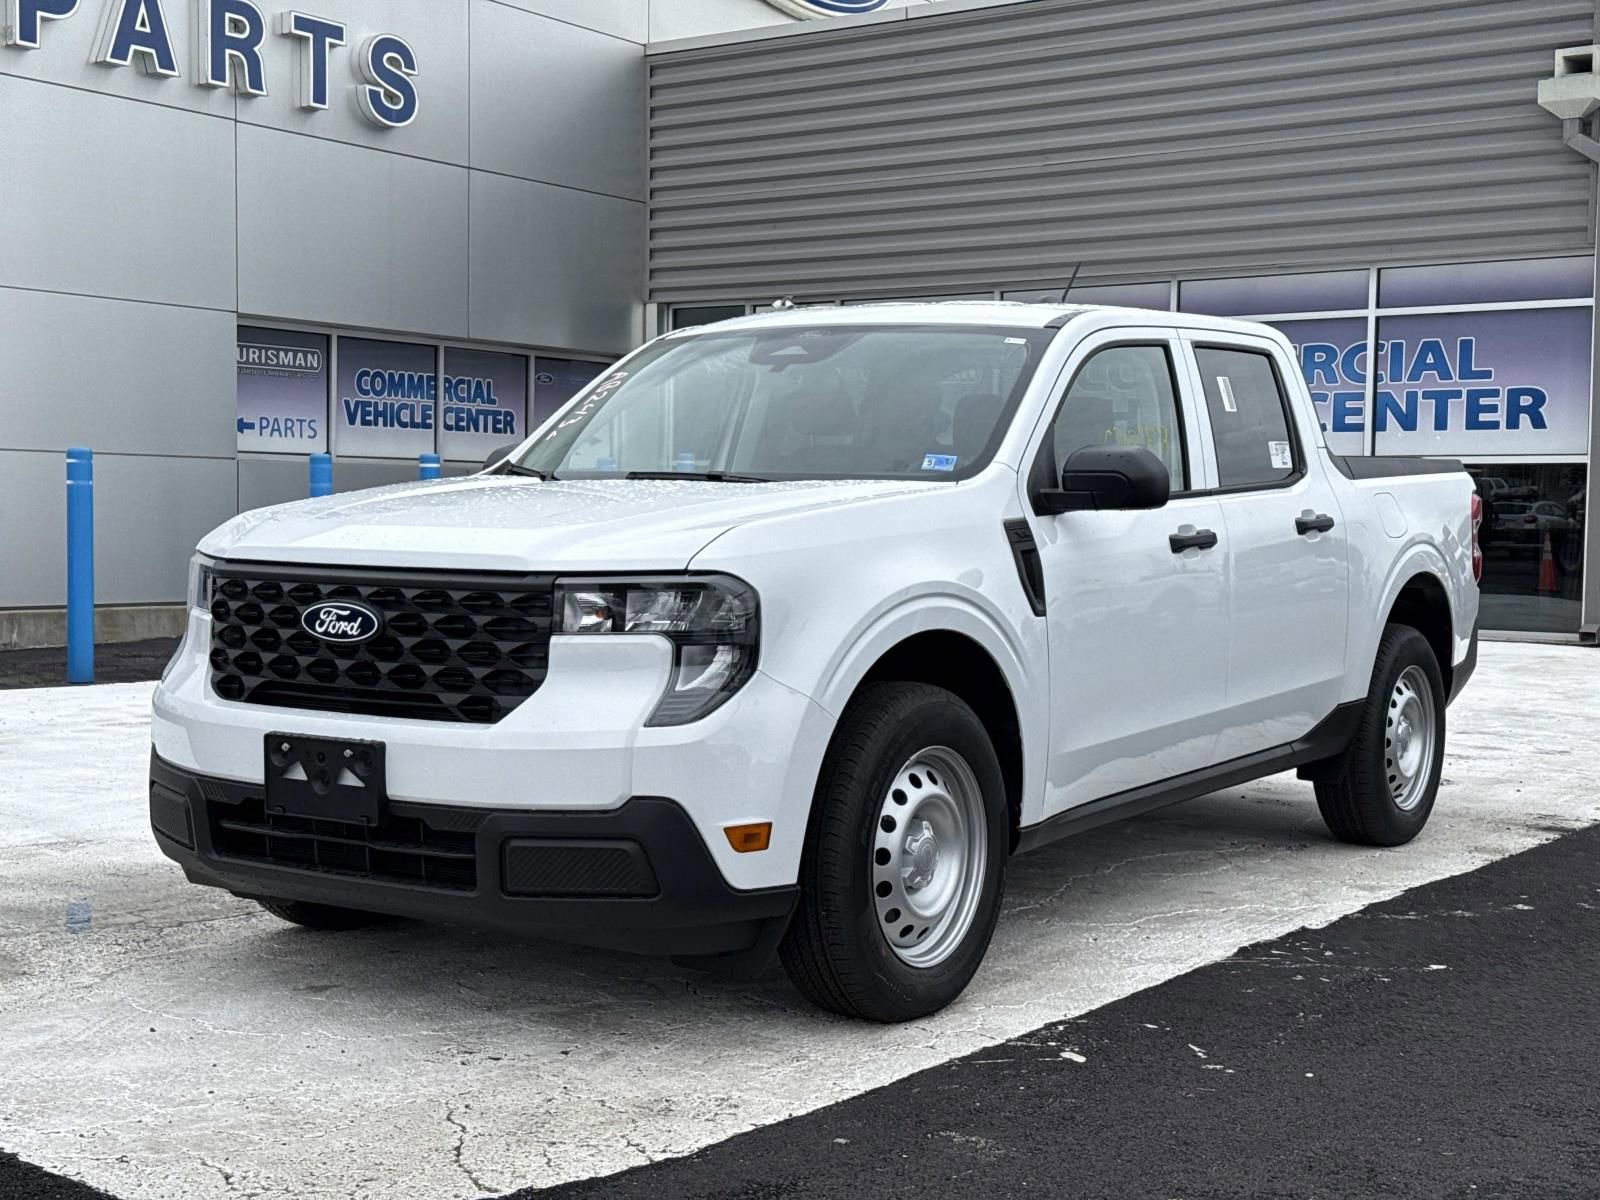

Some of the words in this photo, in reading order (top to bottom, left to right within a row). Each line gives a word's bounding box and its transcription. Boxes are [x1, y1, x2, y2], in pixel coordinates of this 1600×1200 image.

[1293, 337, 1495, 386] RCIAL
[355, 368, 498, 406] COMMERCIAL
[259, 416, 318, 439] PARTS
[343, 398, 433, 430] VEHICLE
[443, 405, 516, 435] CENTER
[315, 607, 363, 636] Ford
